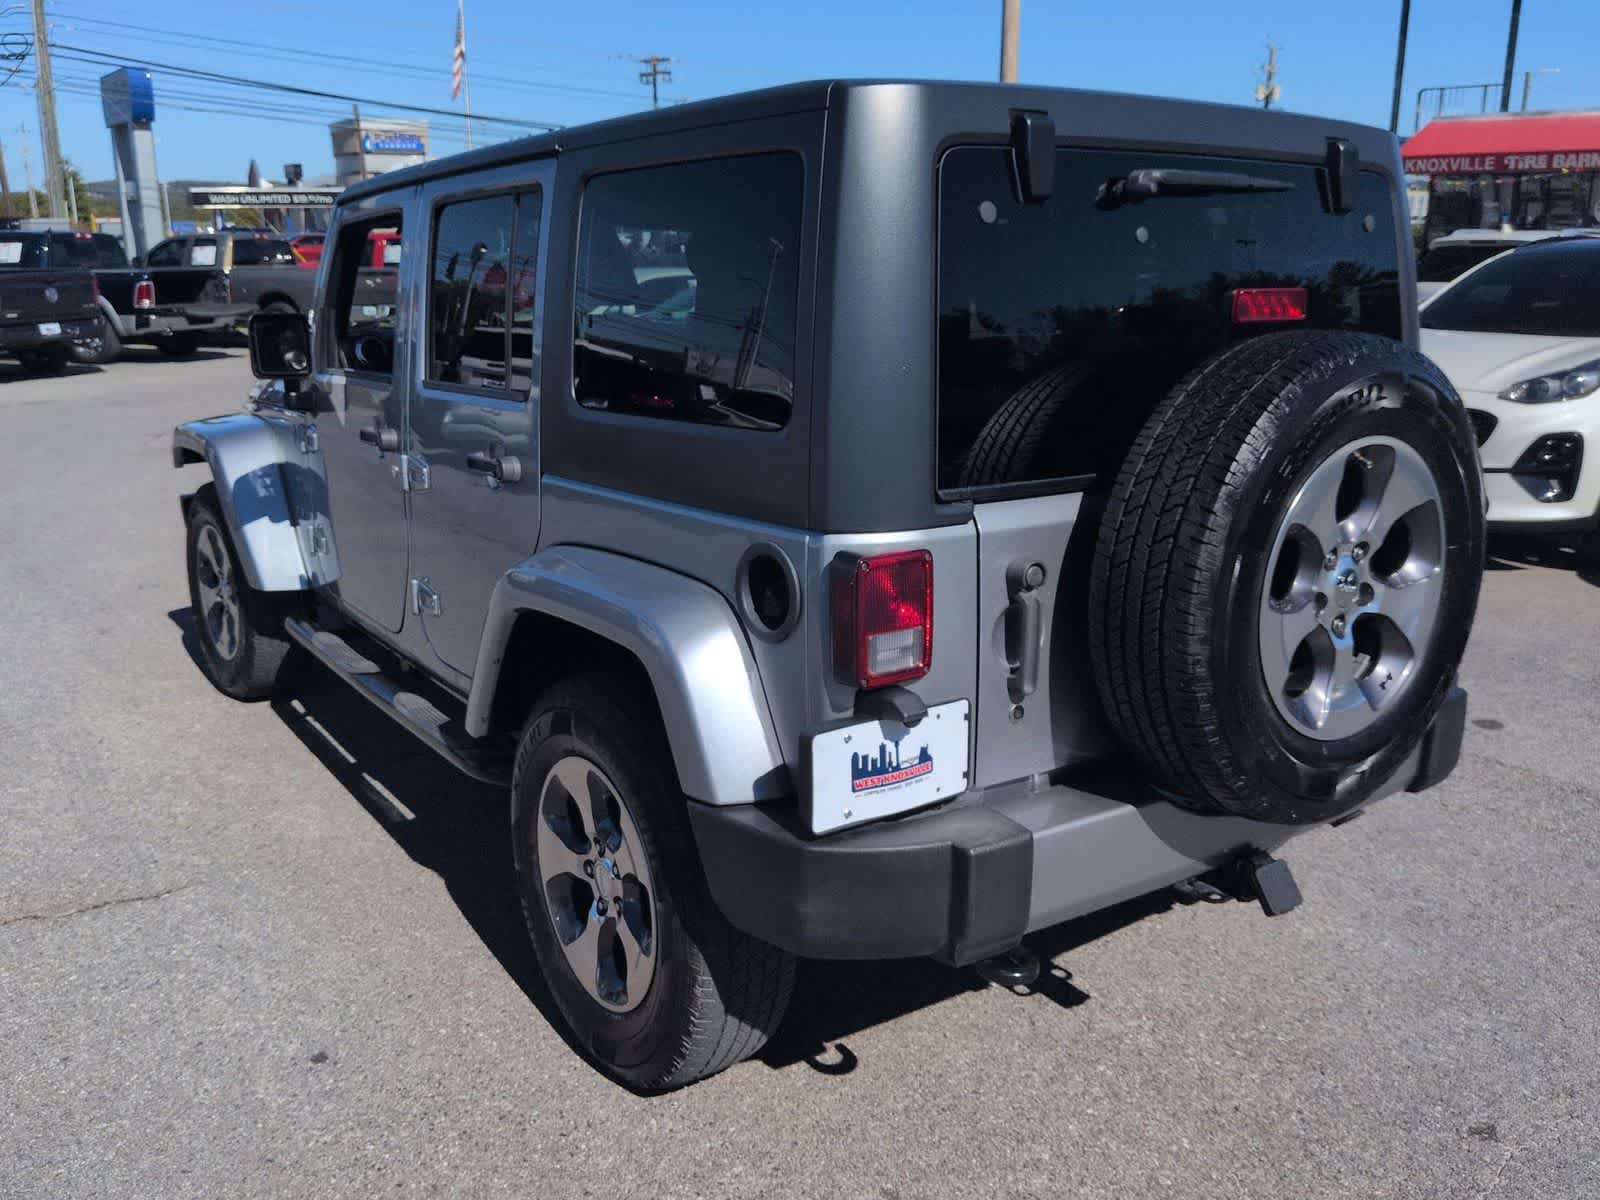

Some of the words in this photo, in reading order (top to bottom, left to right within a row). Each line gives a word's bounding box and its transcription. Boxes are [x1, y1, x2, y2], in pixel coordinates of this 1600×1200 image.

[1405, 156, 1496, 173] KNOXVILLE
[208, 194, 239, 204] WASH
[240, 194, 291, 204] UNLIMITED
[855, 777, 881, 789] WEST
